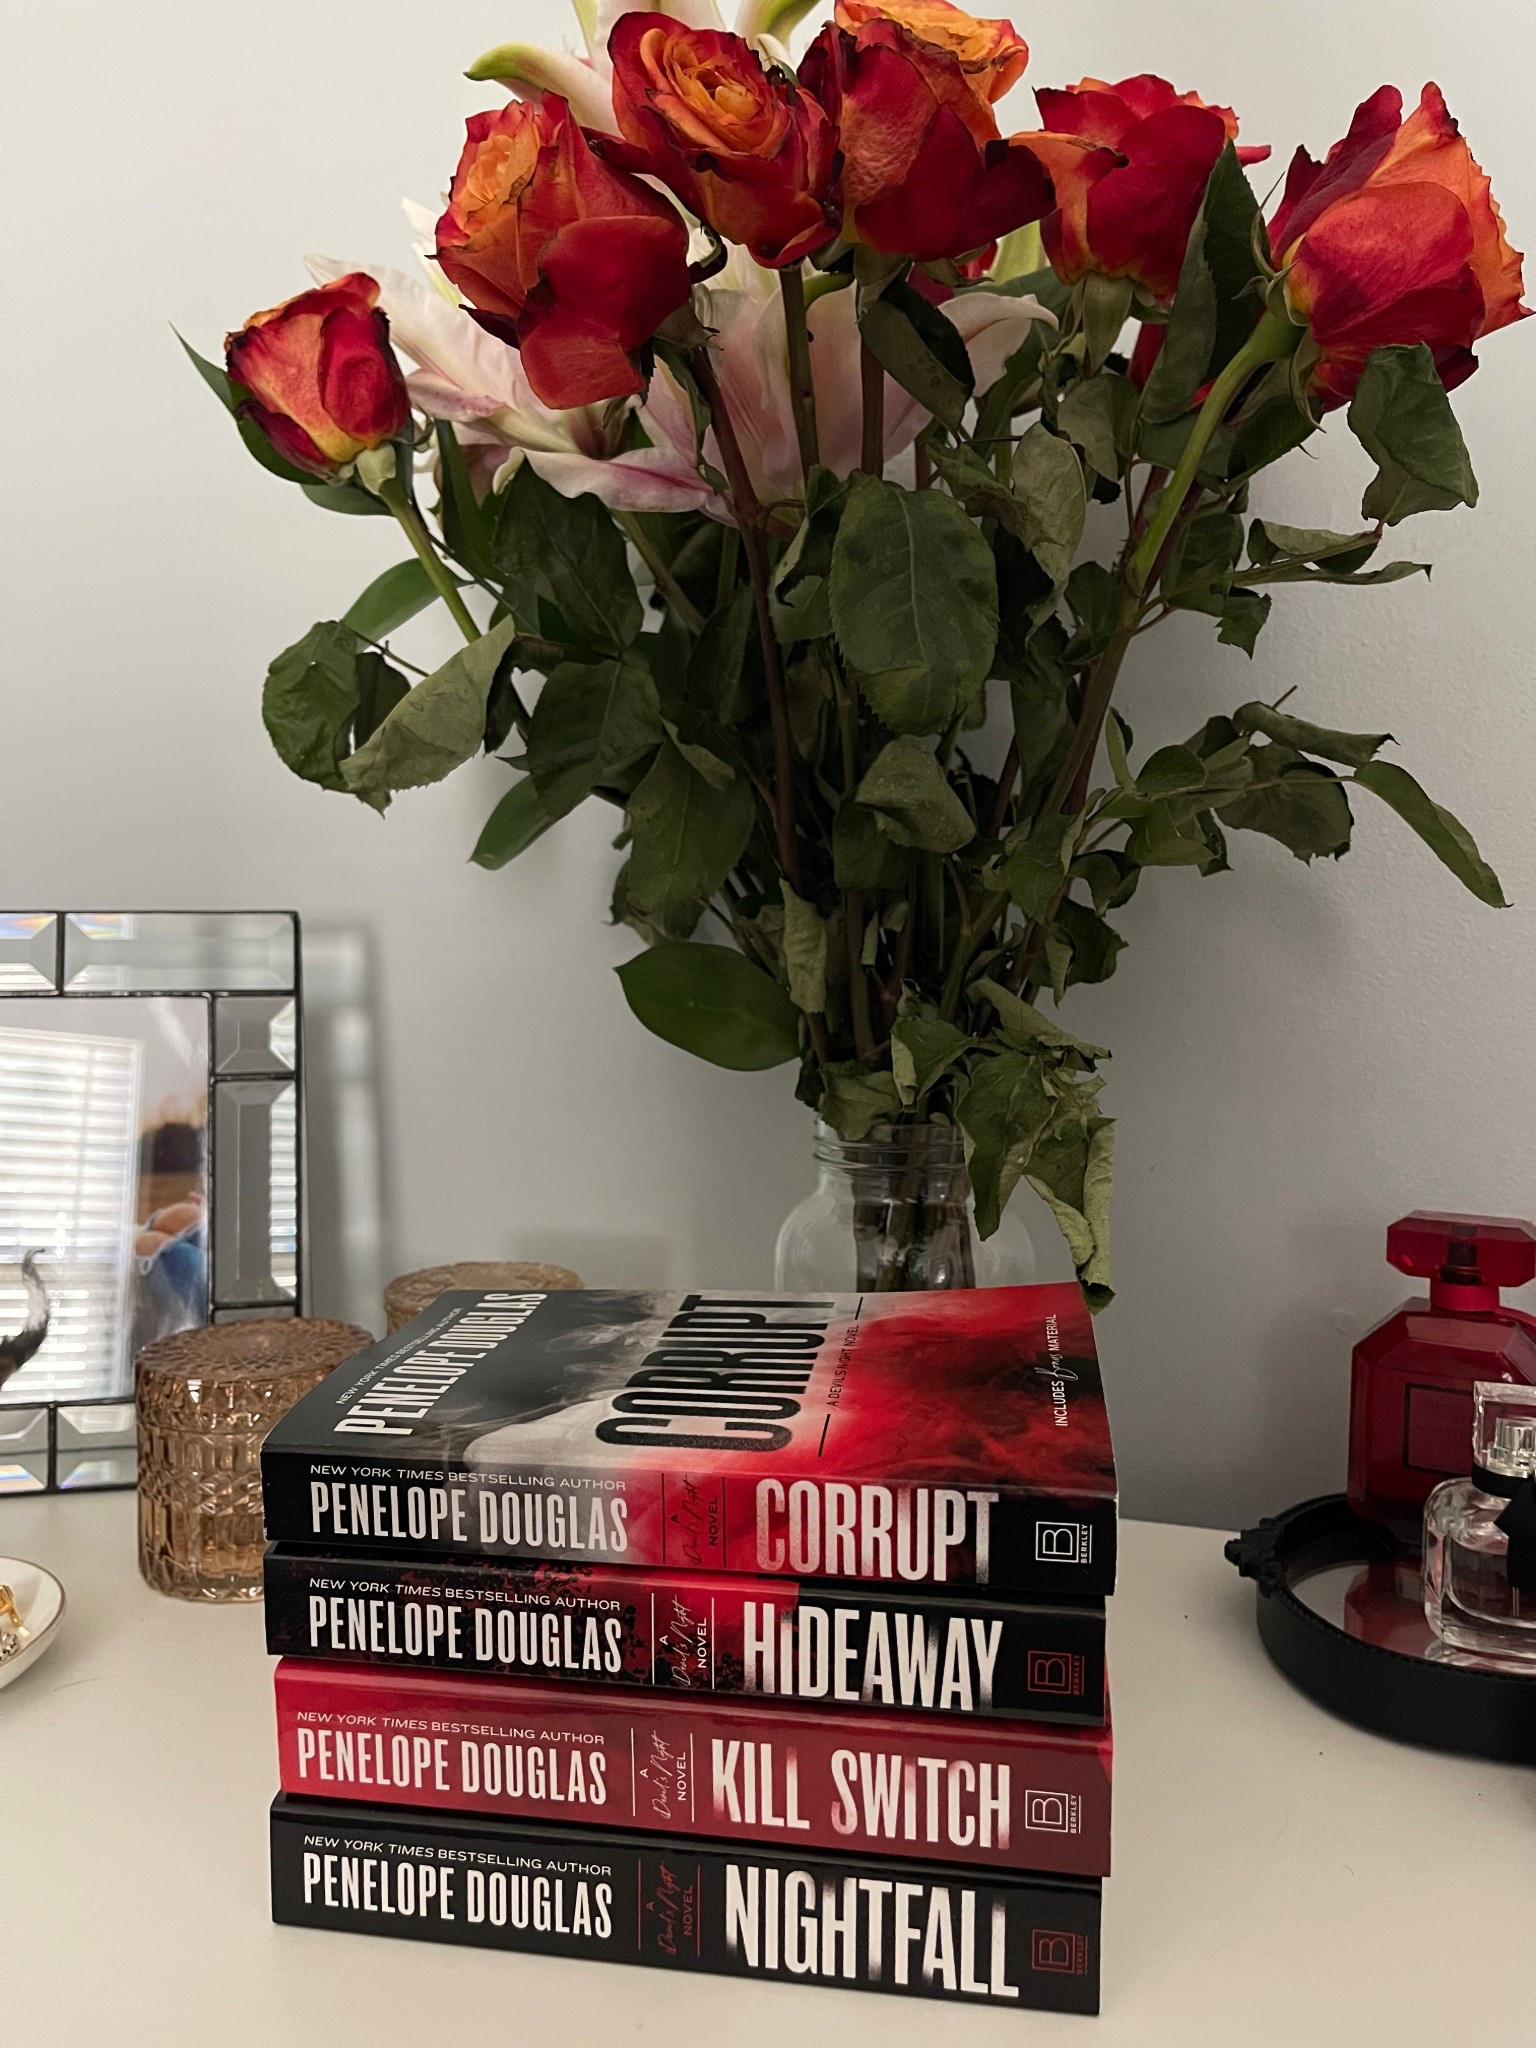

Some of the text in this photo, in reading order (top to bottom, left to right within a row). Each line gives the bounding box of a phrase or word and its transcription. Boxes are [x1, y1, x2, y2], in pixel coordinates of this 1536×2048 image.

[843, 1325, 859, 1346] NOVEL
[1045, 1314, 1060, 1351] MATERIAL
[333, 1293, 548, 1435] PENELOPE DOUGLAS
[336, 1386, 359, 1404] NEW
[354, 1370, 379, 1386] YORK
[375, 1354, 400, 1370] TIMES
[595, 1294, 835, 1452] CORRUPT
[837, 1348, 852, 1369] NIGHT
[1051, 1380, 1068, 1427] INCLUDES
[310, 1465, 627, 1491] NEW YORK TIMES BESTSELLING AUTHOR
[310, 1481, 628, 1553] PENELOPE DOUGLAS
[670, 1514, 680, 1525] A
[708, 1496, 719, 1547] NOVEL
[756, 1478, 999, 1584] CORRUPT
[1080, 1524, 1088, 1564] BERKLEY
[309, 1578, 621, 1611] NEW YORK TIMES BESTSELLING AUTHOR
[309, 1595, 622, 1673] PENELOPE DOUGLAS
[659, 1635, 669, 1646] A
[697, 1617, 707, 1669] NOVEL
[743, 1600, 1003, 1712] HIDEAWAY
[297, 1711, 605, 1745] NEW YORK TIMES BESTSELLING AUTHOR
[297, 1727, 607, 1805] PENELOPE DOUGLAS
[640, 1768, 649, 1779] A
[677, 1751, 687, 1801] NOVEL
[711, 1738, 1011, 1850] KILL SWITCH
[304, 1834, 612, 1876] NEW YORK TIMES BESTSELLING AUTHOR
[303, 1851, 613, 1939] PENELOPE DOUGLAS
[645, 1901, 655, 1912] A
[683, 1885, 693, 1936] NOVEL
[725, 1863, 1020, 1998] NIGHTFALL
